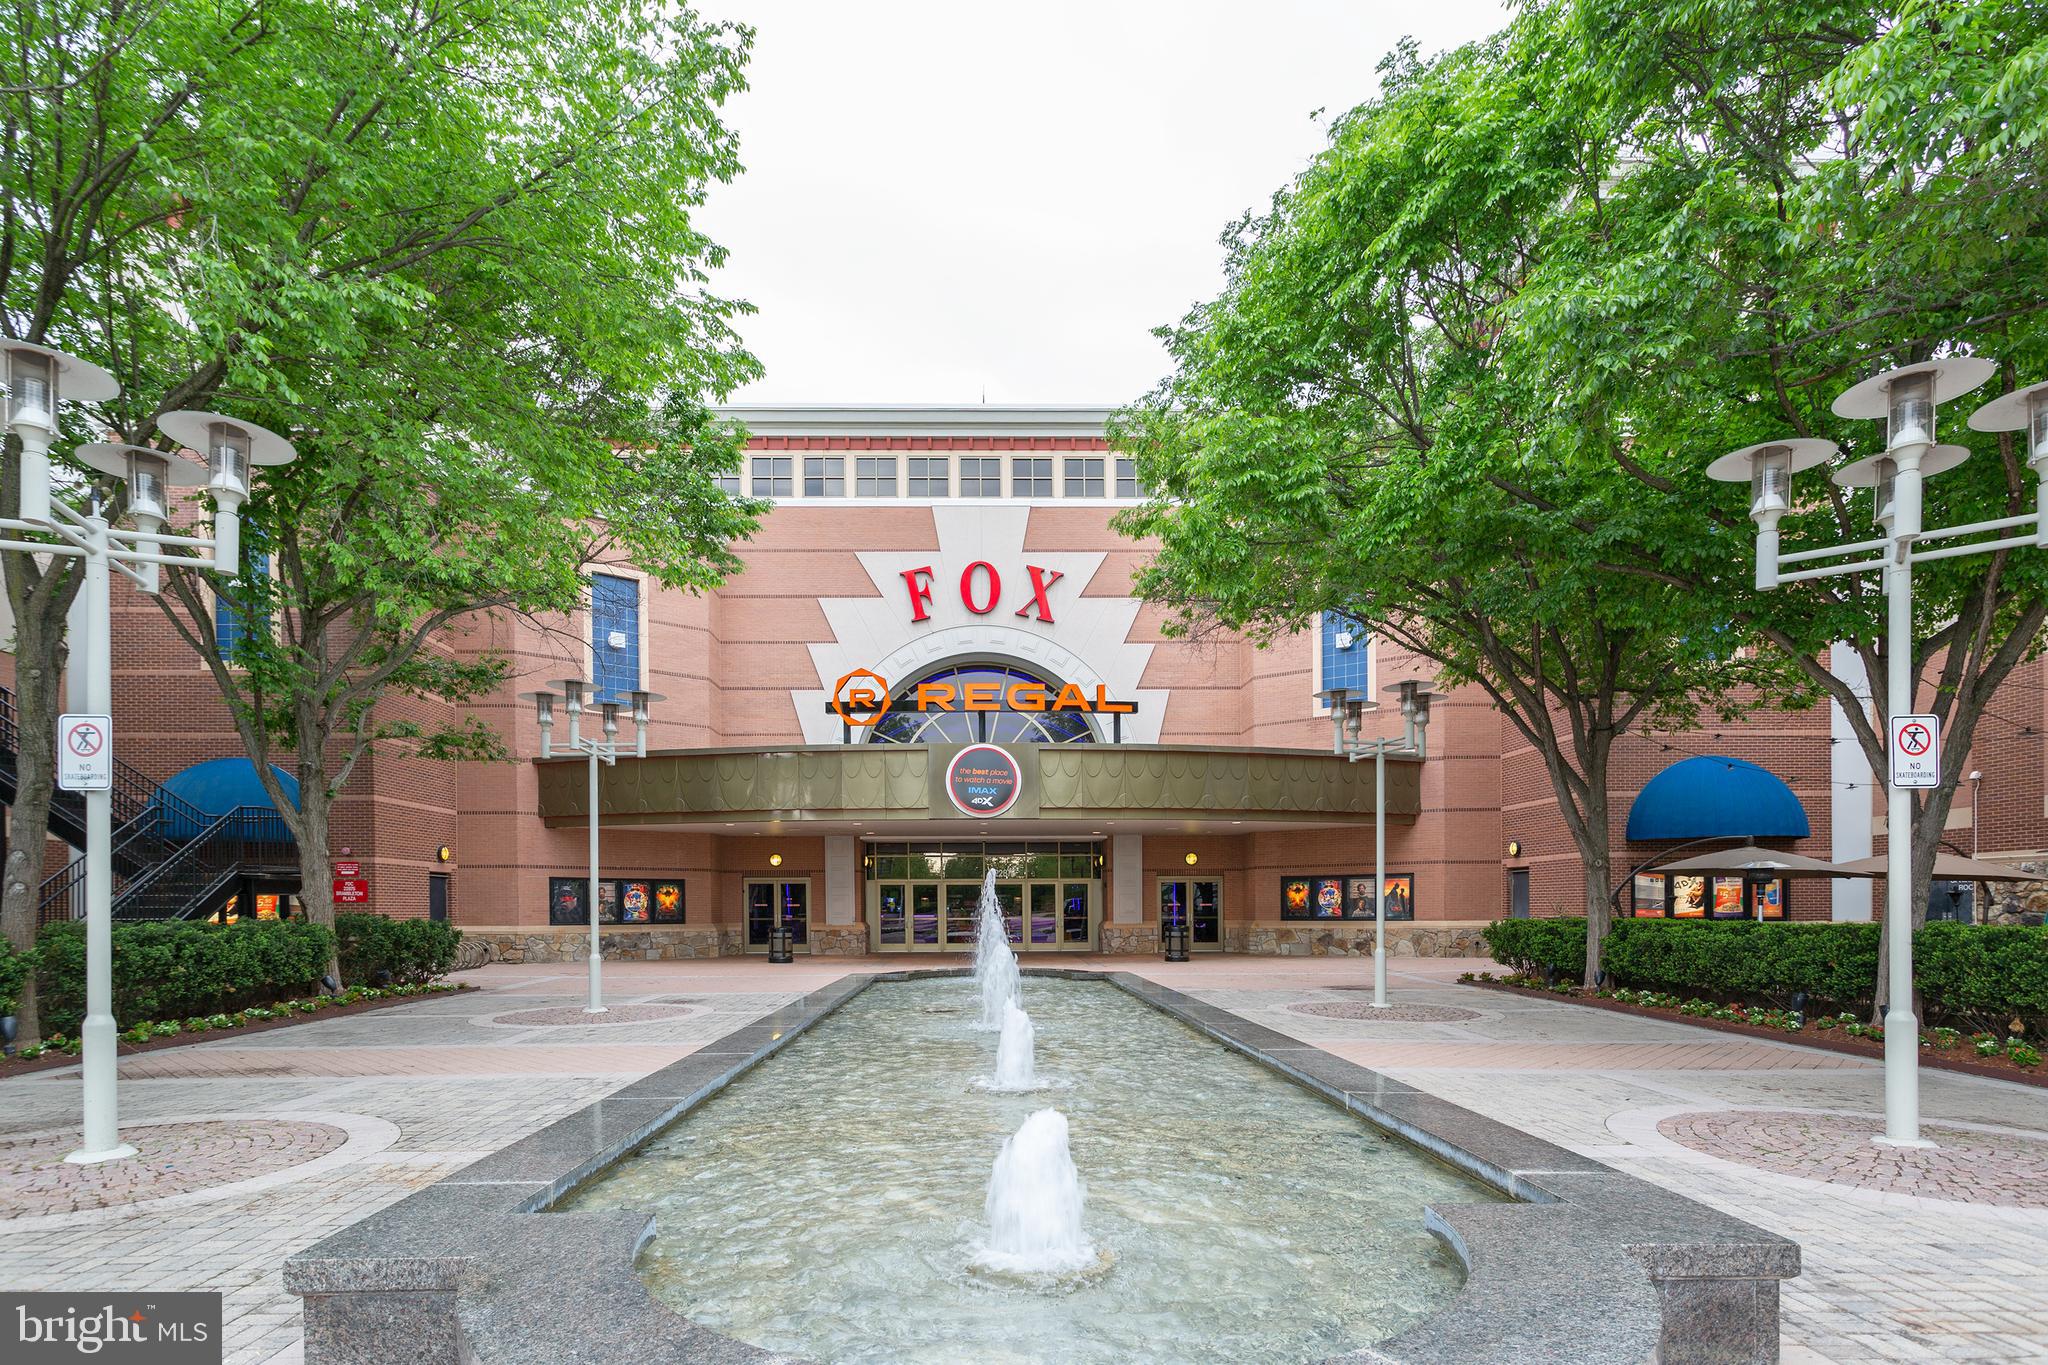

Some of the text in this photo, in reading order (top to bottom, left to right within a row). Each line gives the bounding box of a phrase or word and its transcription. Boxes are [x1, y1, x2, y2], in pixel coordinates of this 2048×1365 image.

[899, 561, 1064, 623] FOX
[917, 683, 1133, 712] REGAL
[1909, 762, 1921, 770] NO
[959, 767, 1009, 777] the best place
[1896, 771, 1936, 779] SKATEBOARDING
[64, 773, 108, 781] SKATEBOARDING
[964, 776, 986, 784] watch
[968, 786, 998, 795] IMAX
[971, 796, 994, 807] 4DX
